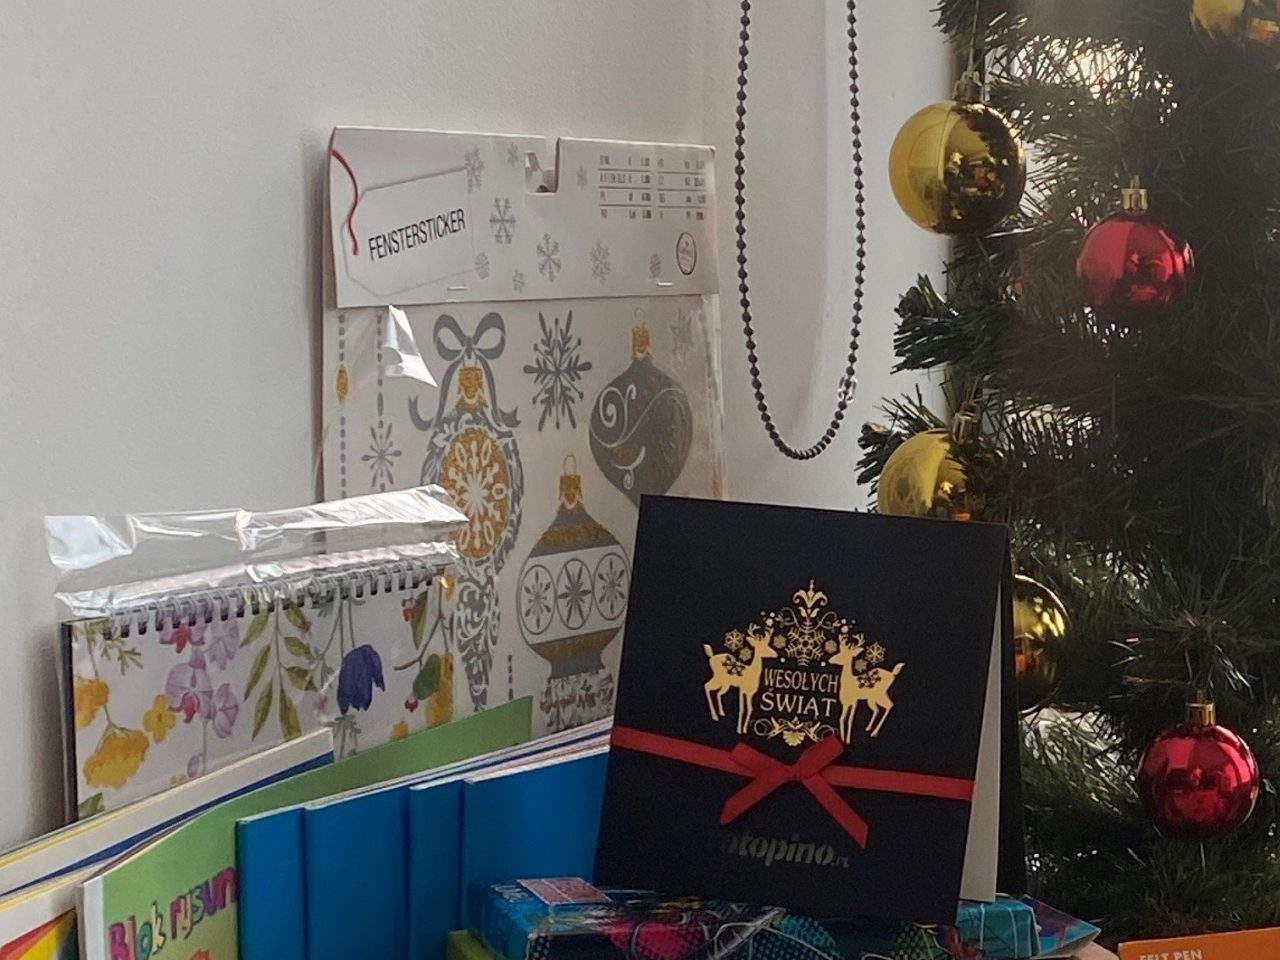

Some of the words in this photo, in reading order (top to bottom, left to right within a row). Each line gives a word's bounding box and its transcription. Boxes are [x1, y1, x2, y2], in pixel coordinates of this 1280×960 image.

[369, 209, 466, 261] FENSTERSTICKER
[764, 668, 839, 693] WESOŁYCH
[760, 688, 837, 719] ŚWIĄT
